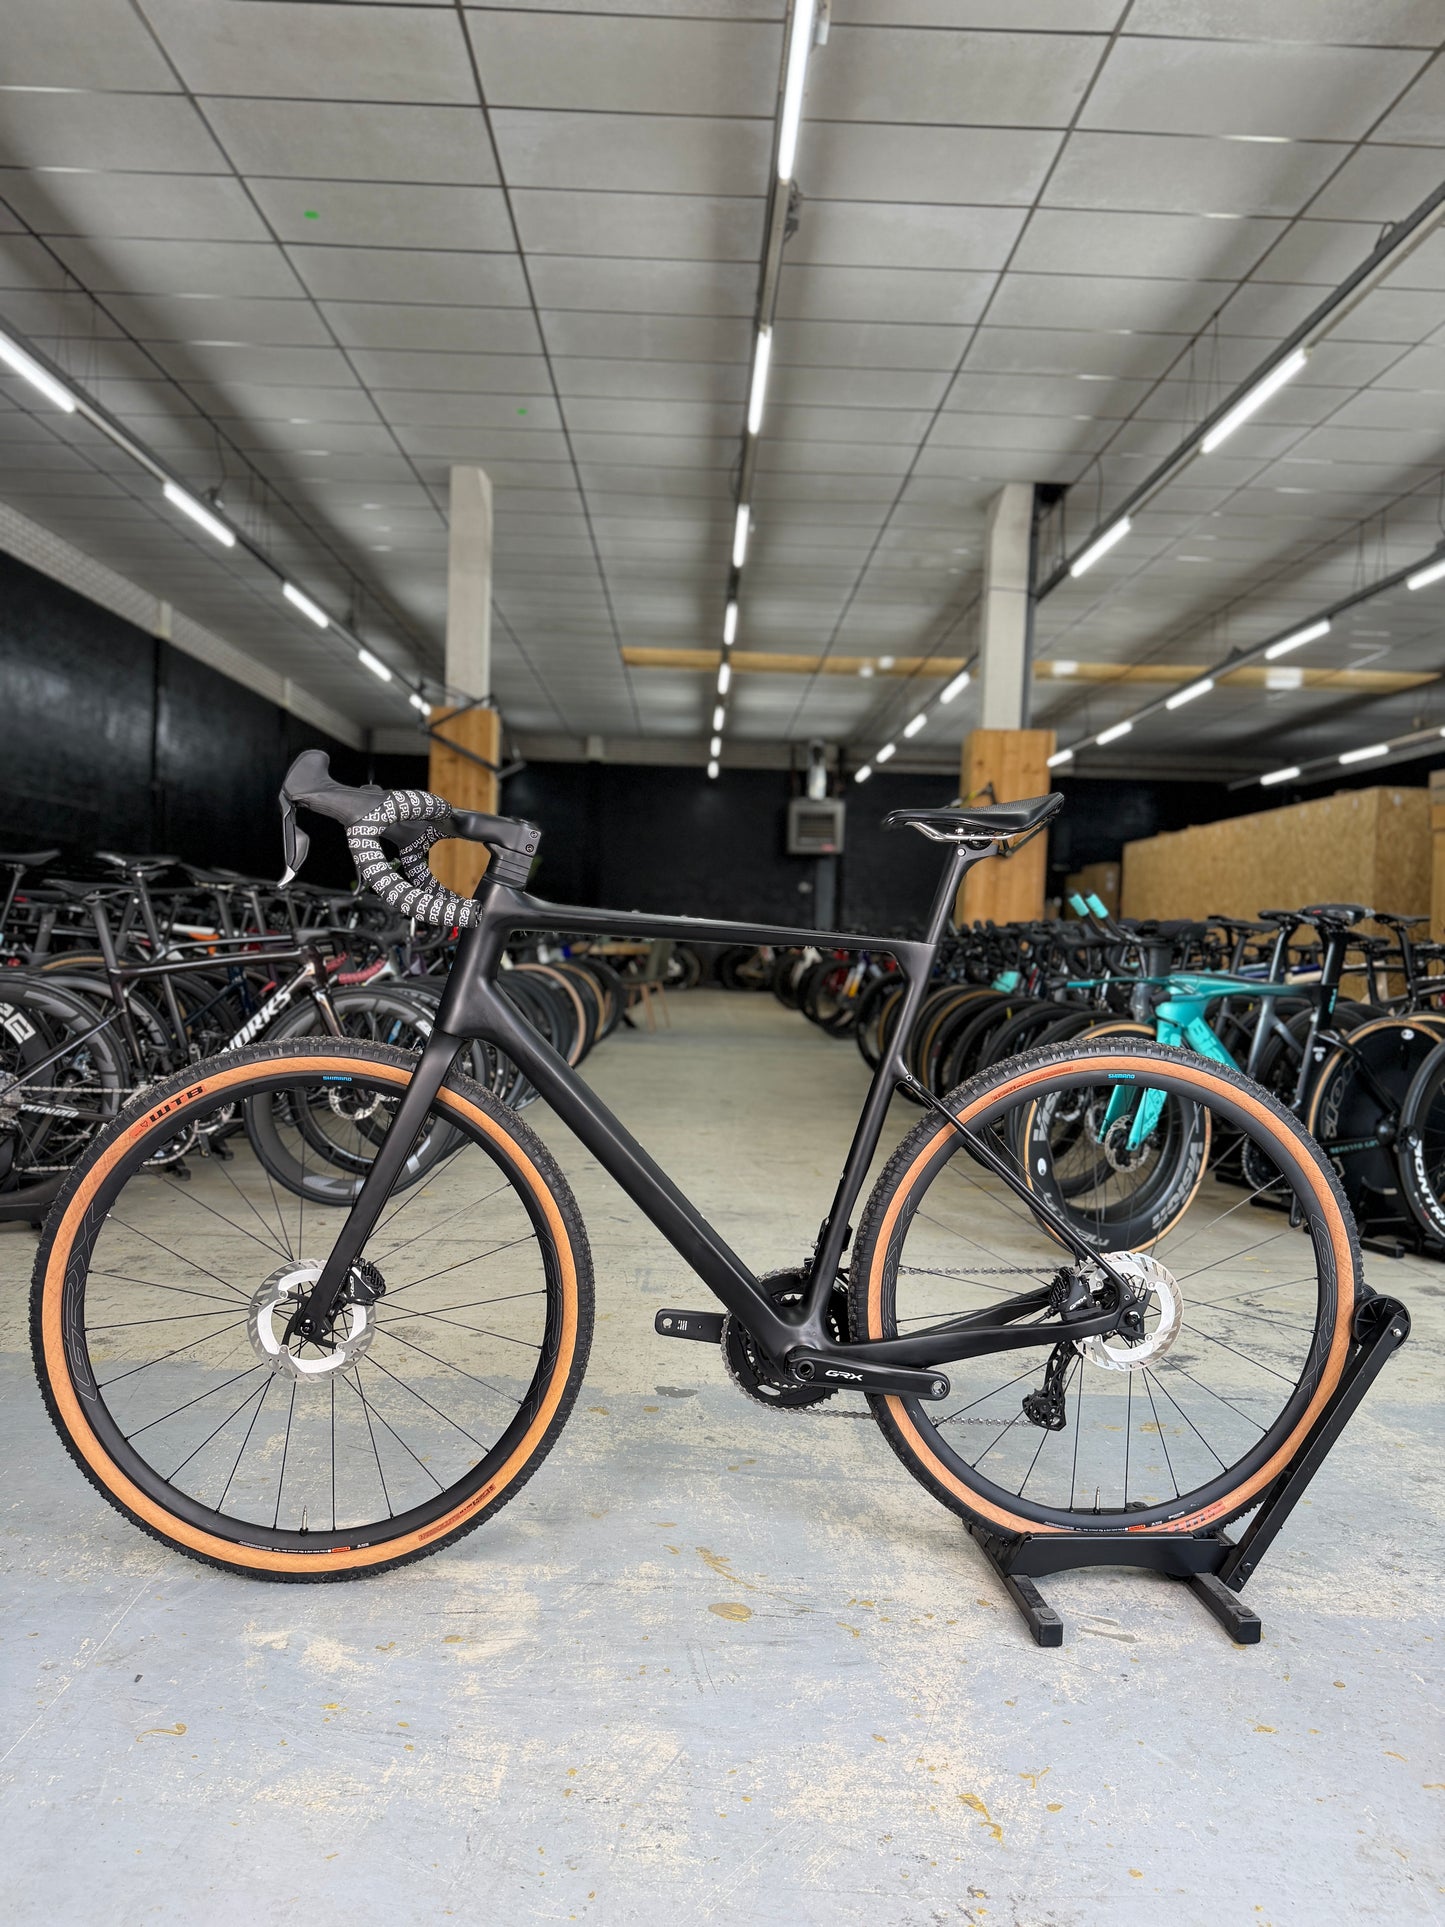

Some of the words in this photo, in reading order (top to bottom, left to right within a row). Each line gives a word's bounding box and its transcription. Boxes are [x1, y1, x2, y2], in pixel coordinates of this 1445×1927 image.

[352, 825, 378, 836] PRO
[359, 851, 384, 862] PRO
[363, 861, 388, 879] PRO
[429, 899, 443, 922] PRO
[219, 983, 291, 1054] ORKS
[149, 1086, 203, 1122] WTB
[824, 1369, 864, 1381] GRX
